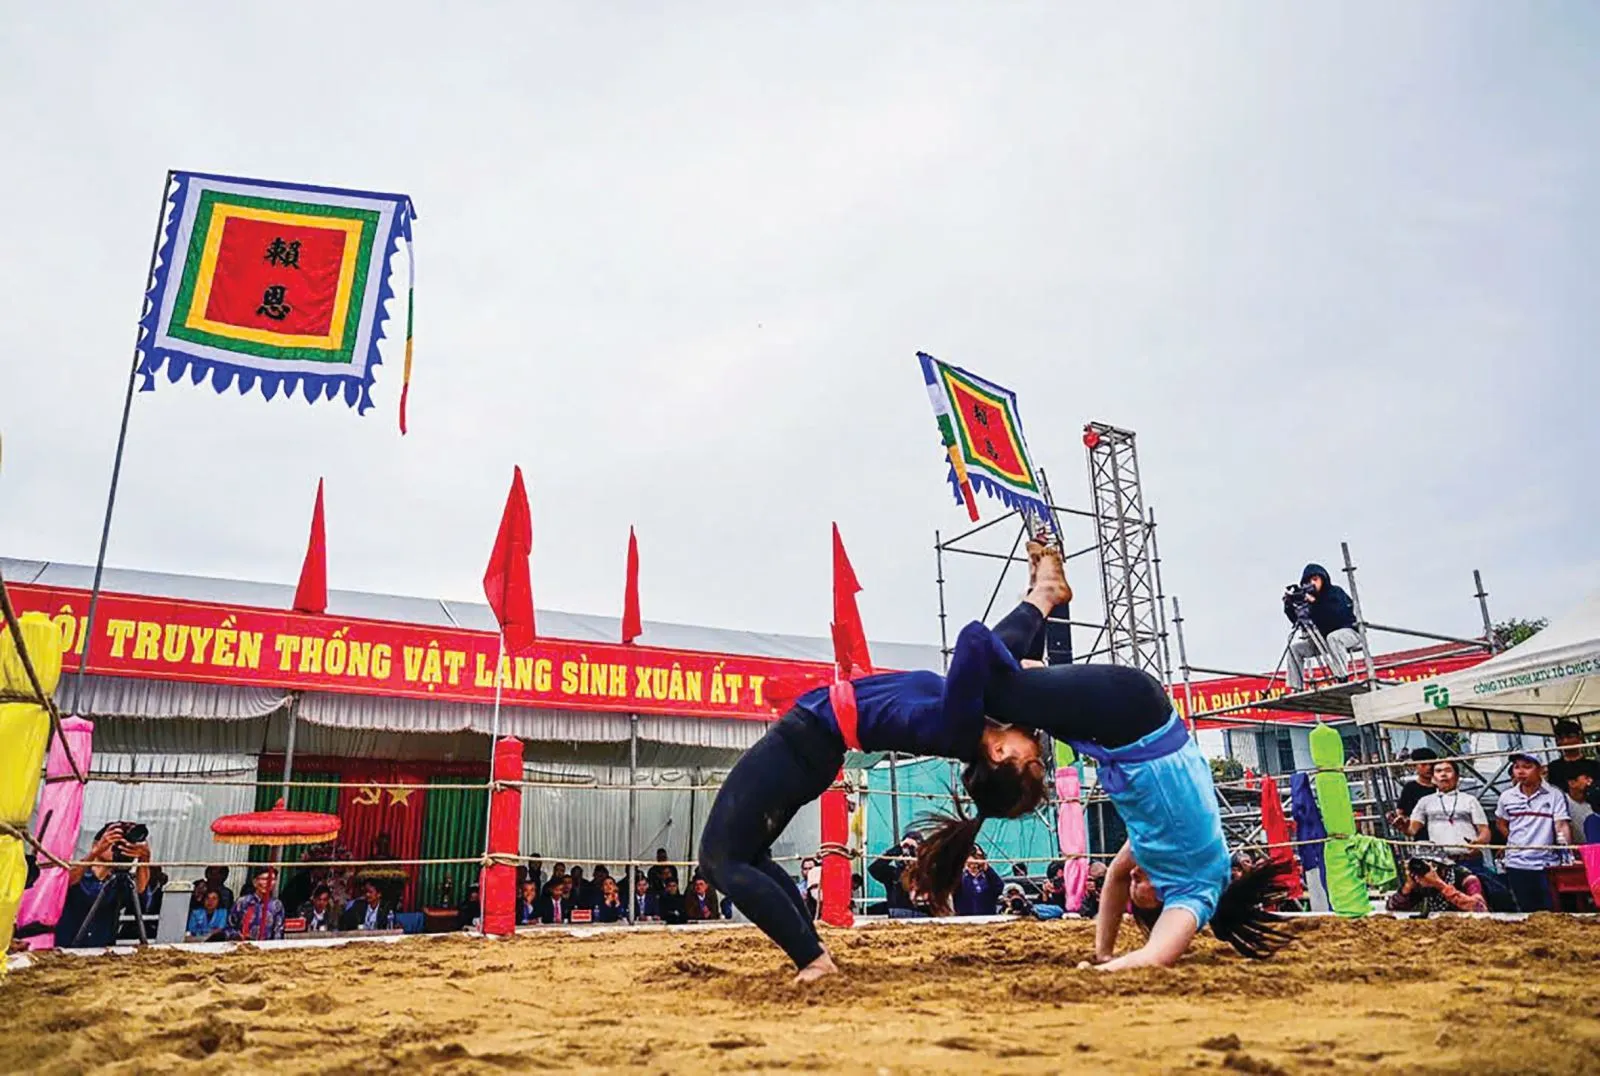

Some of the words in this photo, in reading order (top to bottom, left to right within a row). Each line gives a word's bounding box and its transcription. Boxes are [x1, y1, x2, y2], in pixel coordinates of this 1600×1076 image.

[106, 615, 264, 668] TRUYỀN
[275, 626, 392, 680] THỐNG
[403, 640, 466, 692] VẬT
[561, 653, 628, 697] SÌNH
[635, 662, 703, 702] XUÂN
[710, 661, 743, 704] ẤT
